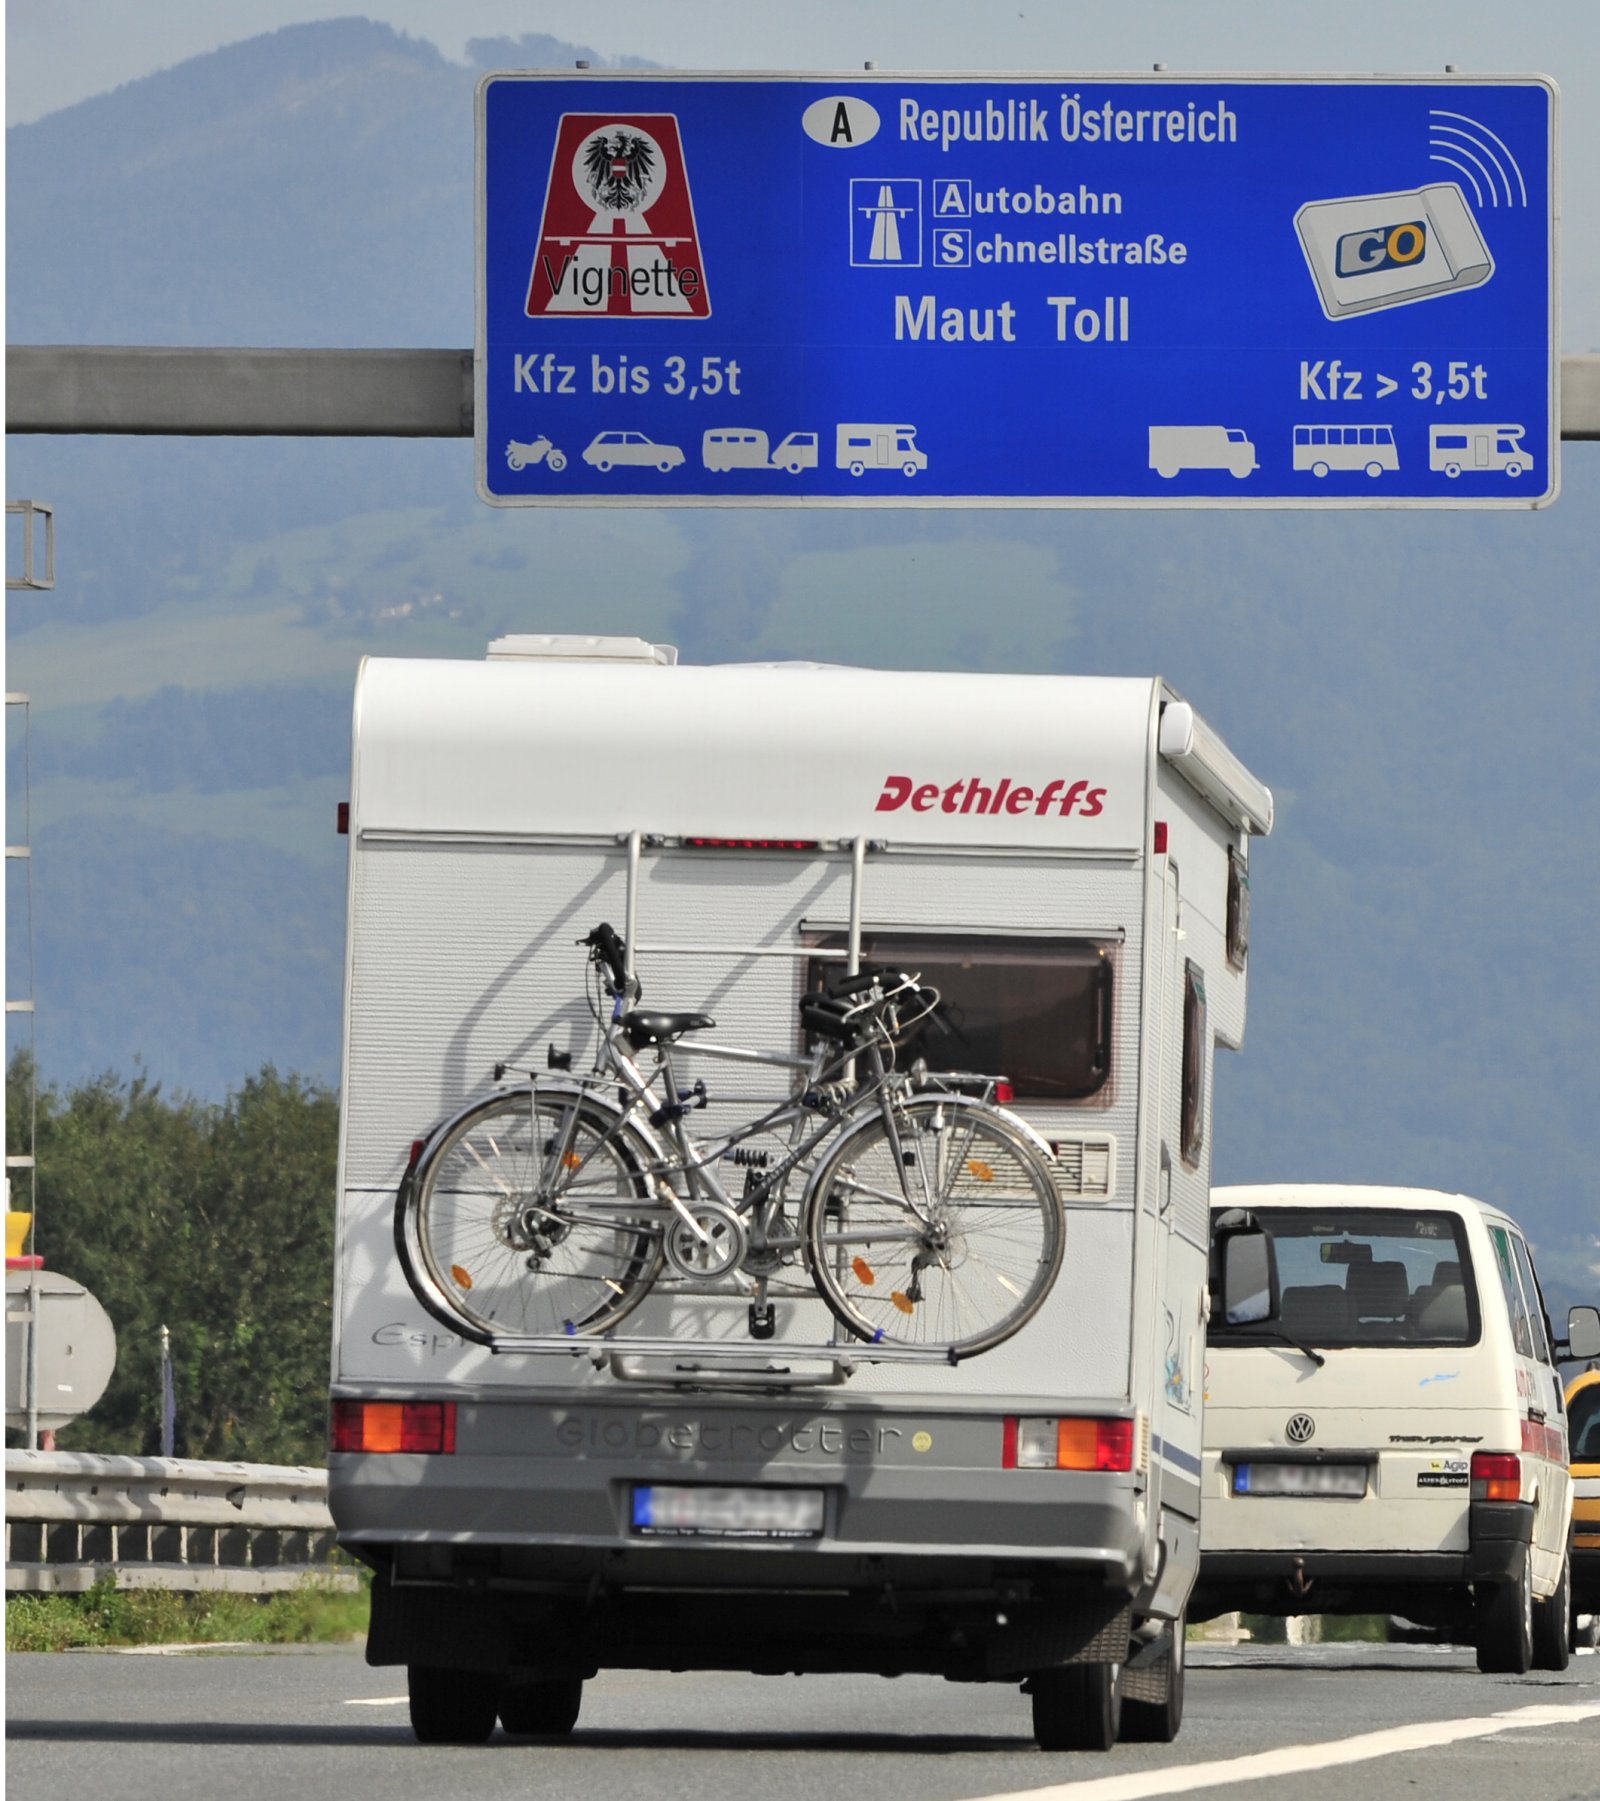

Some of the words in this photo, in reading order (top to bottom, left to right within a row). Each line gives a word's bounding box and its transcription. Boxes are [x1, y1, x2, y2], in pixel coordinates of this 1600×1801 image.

[830, 101, 853, 143] A
[900, 98, 1049, 152] Republik
[1060, 93, 1237, 143] Österreich
[939, 184, 1122, 215] Autobahn
[940, 232, 1188, 265] Schnellstraße
[1340, 224, 1426, 274] GO
[542, 253, 700, 307] Vignette
[895, 295, 1016, 342] Maut
[1047, 296, 1129, 342] Toll
[514, 353, 576, 394] Kfz
[591, 354, 650, 395] bis
[664, 356, 741, 400] 3,5t
[1300, 360, 1363, 401] Kfz
[1411, 361, 1488, 405] 3,5t
[875, 776, 1107, 817] Dethleffs
[556, 1416, 903, 1454] Globetrotter
